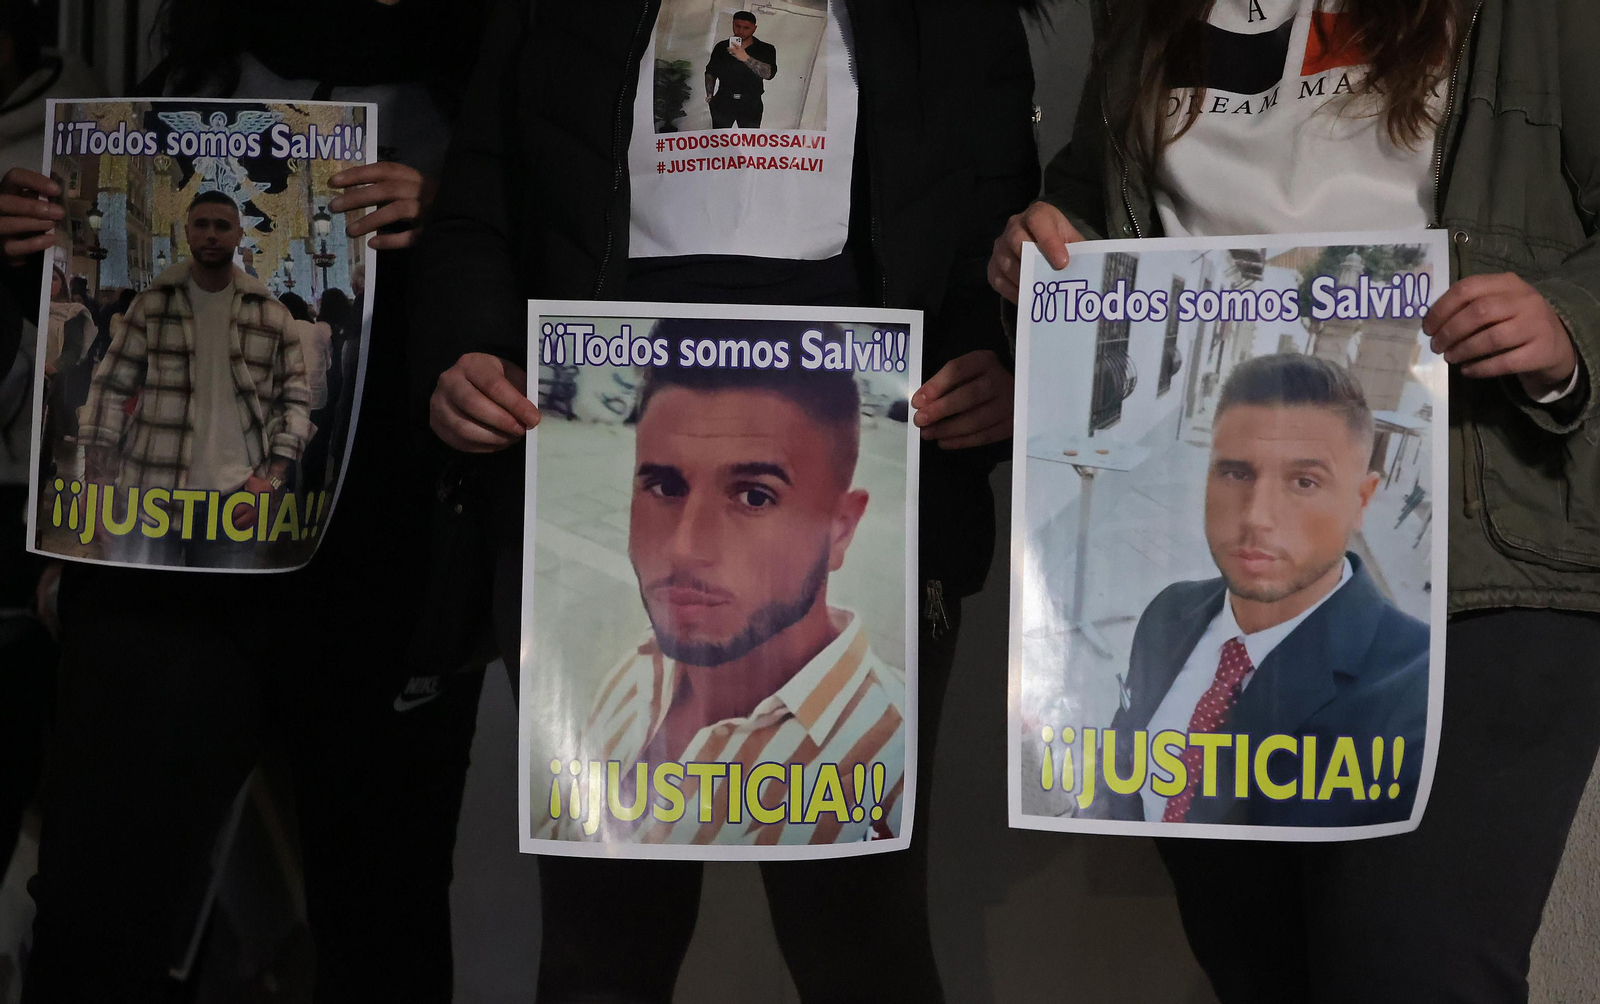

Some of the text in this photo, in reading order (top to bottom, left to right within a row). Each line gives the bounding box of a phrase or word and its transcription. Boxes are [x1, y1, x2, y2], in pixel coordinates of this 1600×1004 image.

[166, 130, 261, 158] somos
[270, 123, 364, 161] Salvi!!
[656, 133, 825, 152] #TODOSSOMOSSALVI
[656, 155, 823, 174] #JUSTICIAPARASALVI
[1178, 286, 1300, 323] somos
[1310, 272, 1431, 321] Salvi!!
[678, 335, 791, 370] somos
[800, 328, 908, 373] Salvi!!
[404, 676, 441, 694] NIKE
